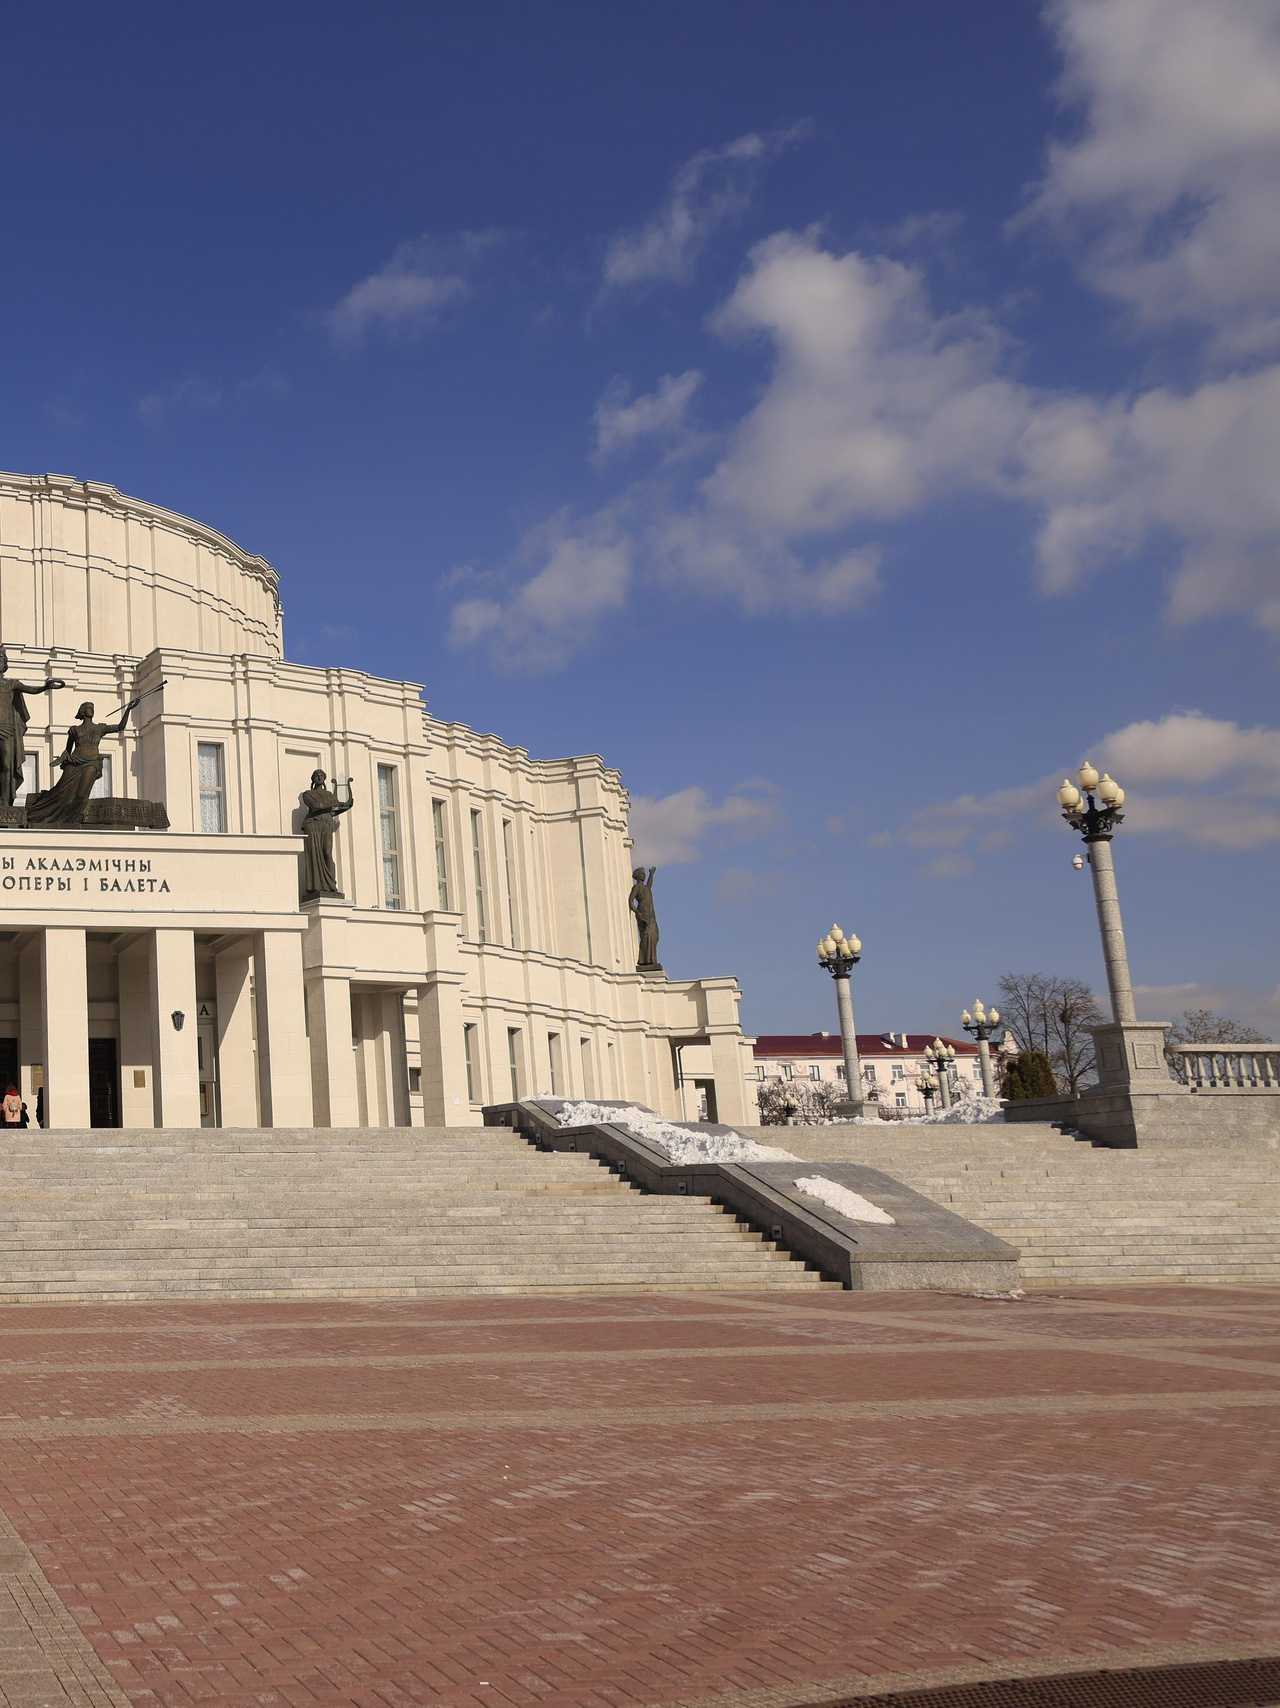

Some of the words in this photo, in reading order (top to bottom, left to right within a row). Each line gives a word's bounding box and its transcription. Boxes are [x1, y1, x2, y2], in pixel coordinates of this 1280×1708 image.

[25, 858, 151, 872] АКАДЭМІЧНЫ
[2, 876, 72, 891] ОПЕРЫ
[83, 878, 89, 891] І
[99, 878, 171, 892] БАЛЕТА
